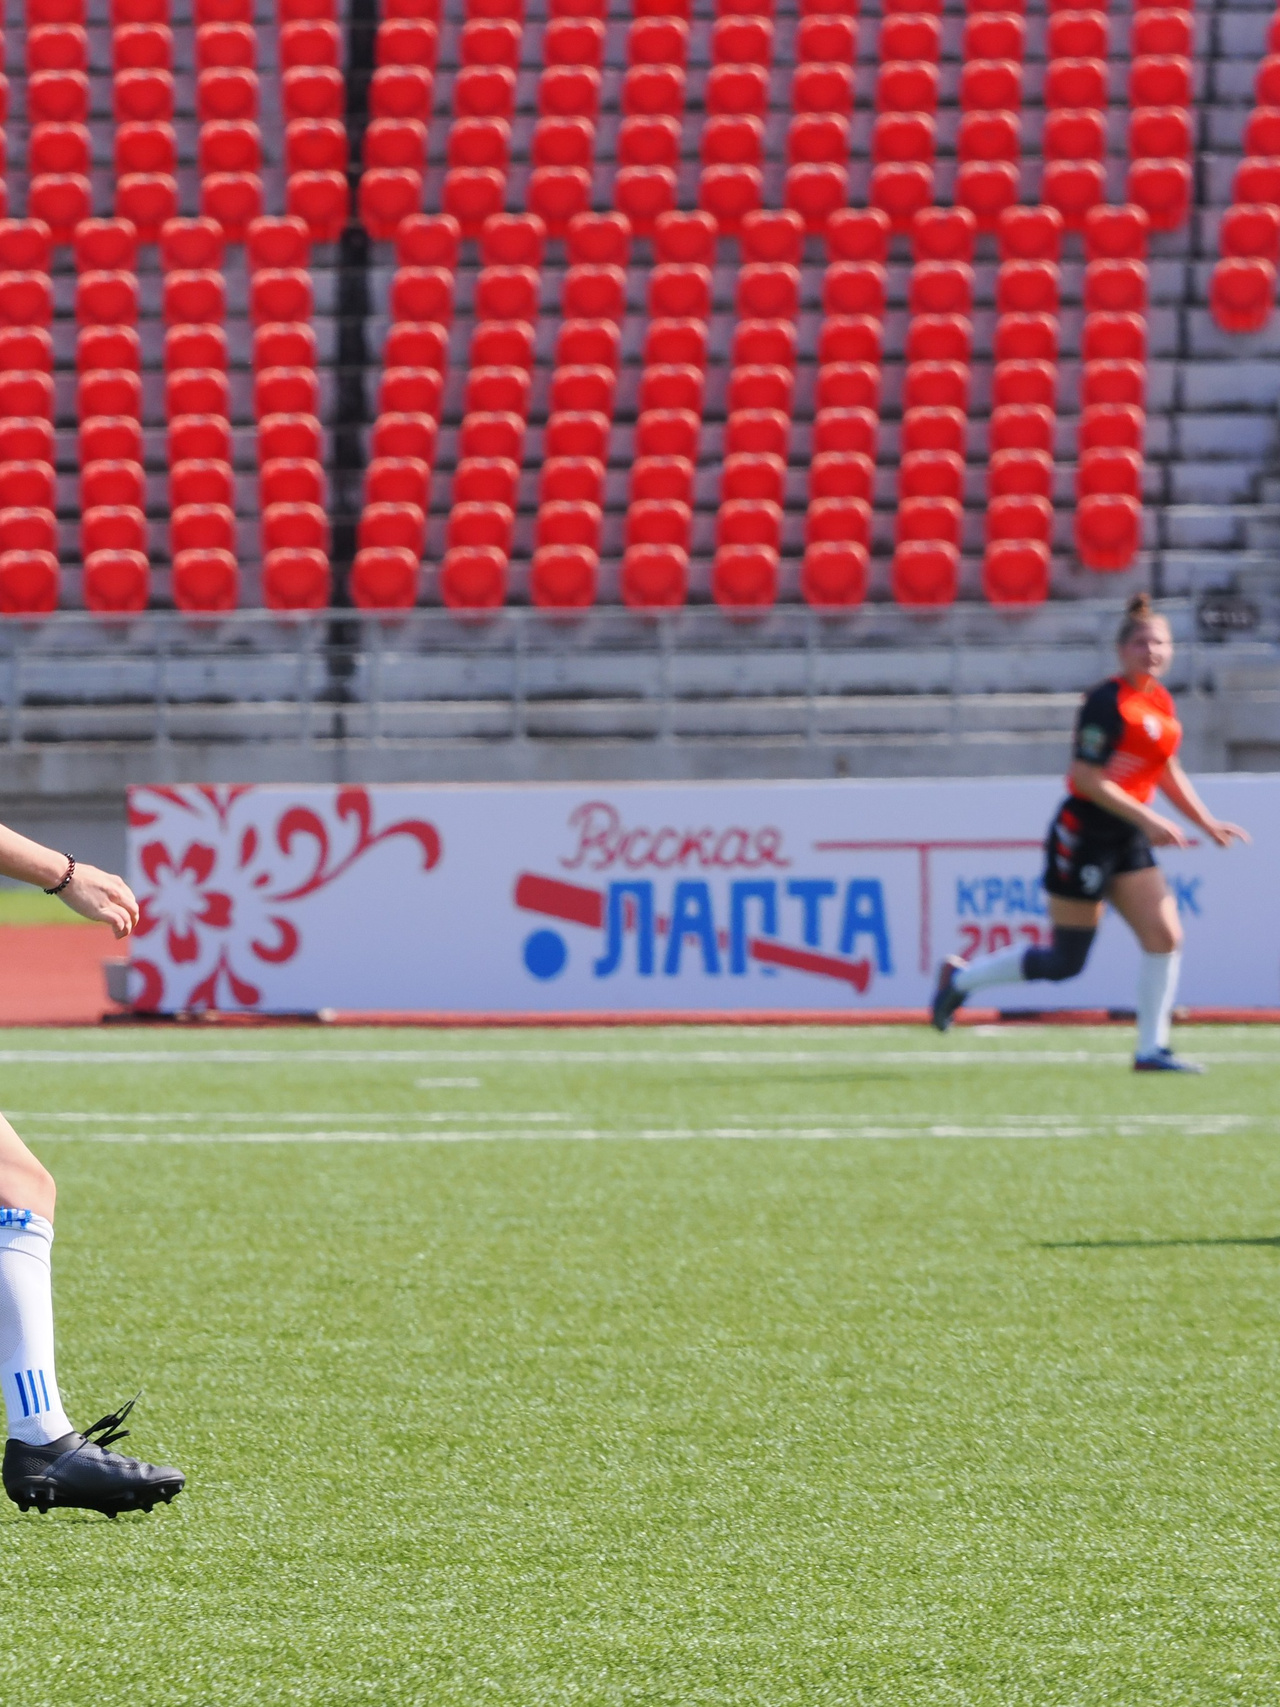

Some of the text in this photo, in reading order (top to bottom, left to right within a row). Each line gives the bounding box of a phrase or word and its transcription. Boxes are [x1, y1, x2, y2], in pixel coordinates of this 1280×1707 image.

[559, 800, 792, 870] Русская
[594, 878, 892, 978] ЛАПТА
[958, 923, 1054, 963] 202
